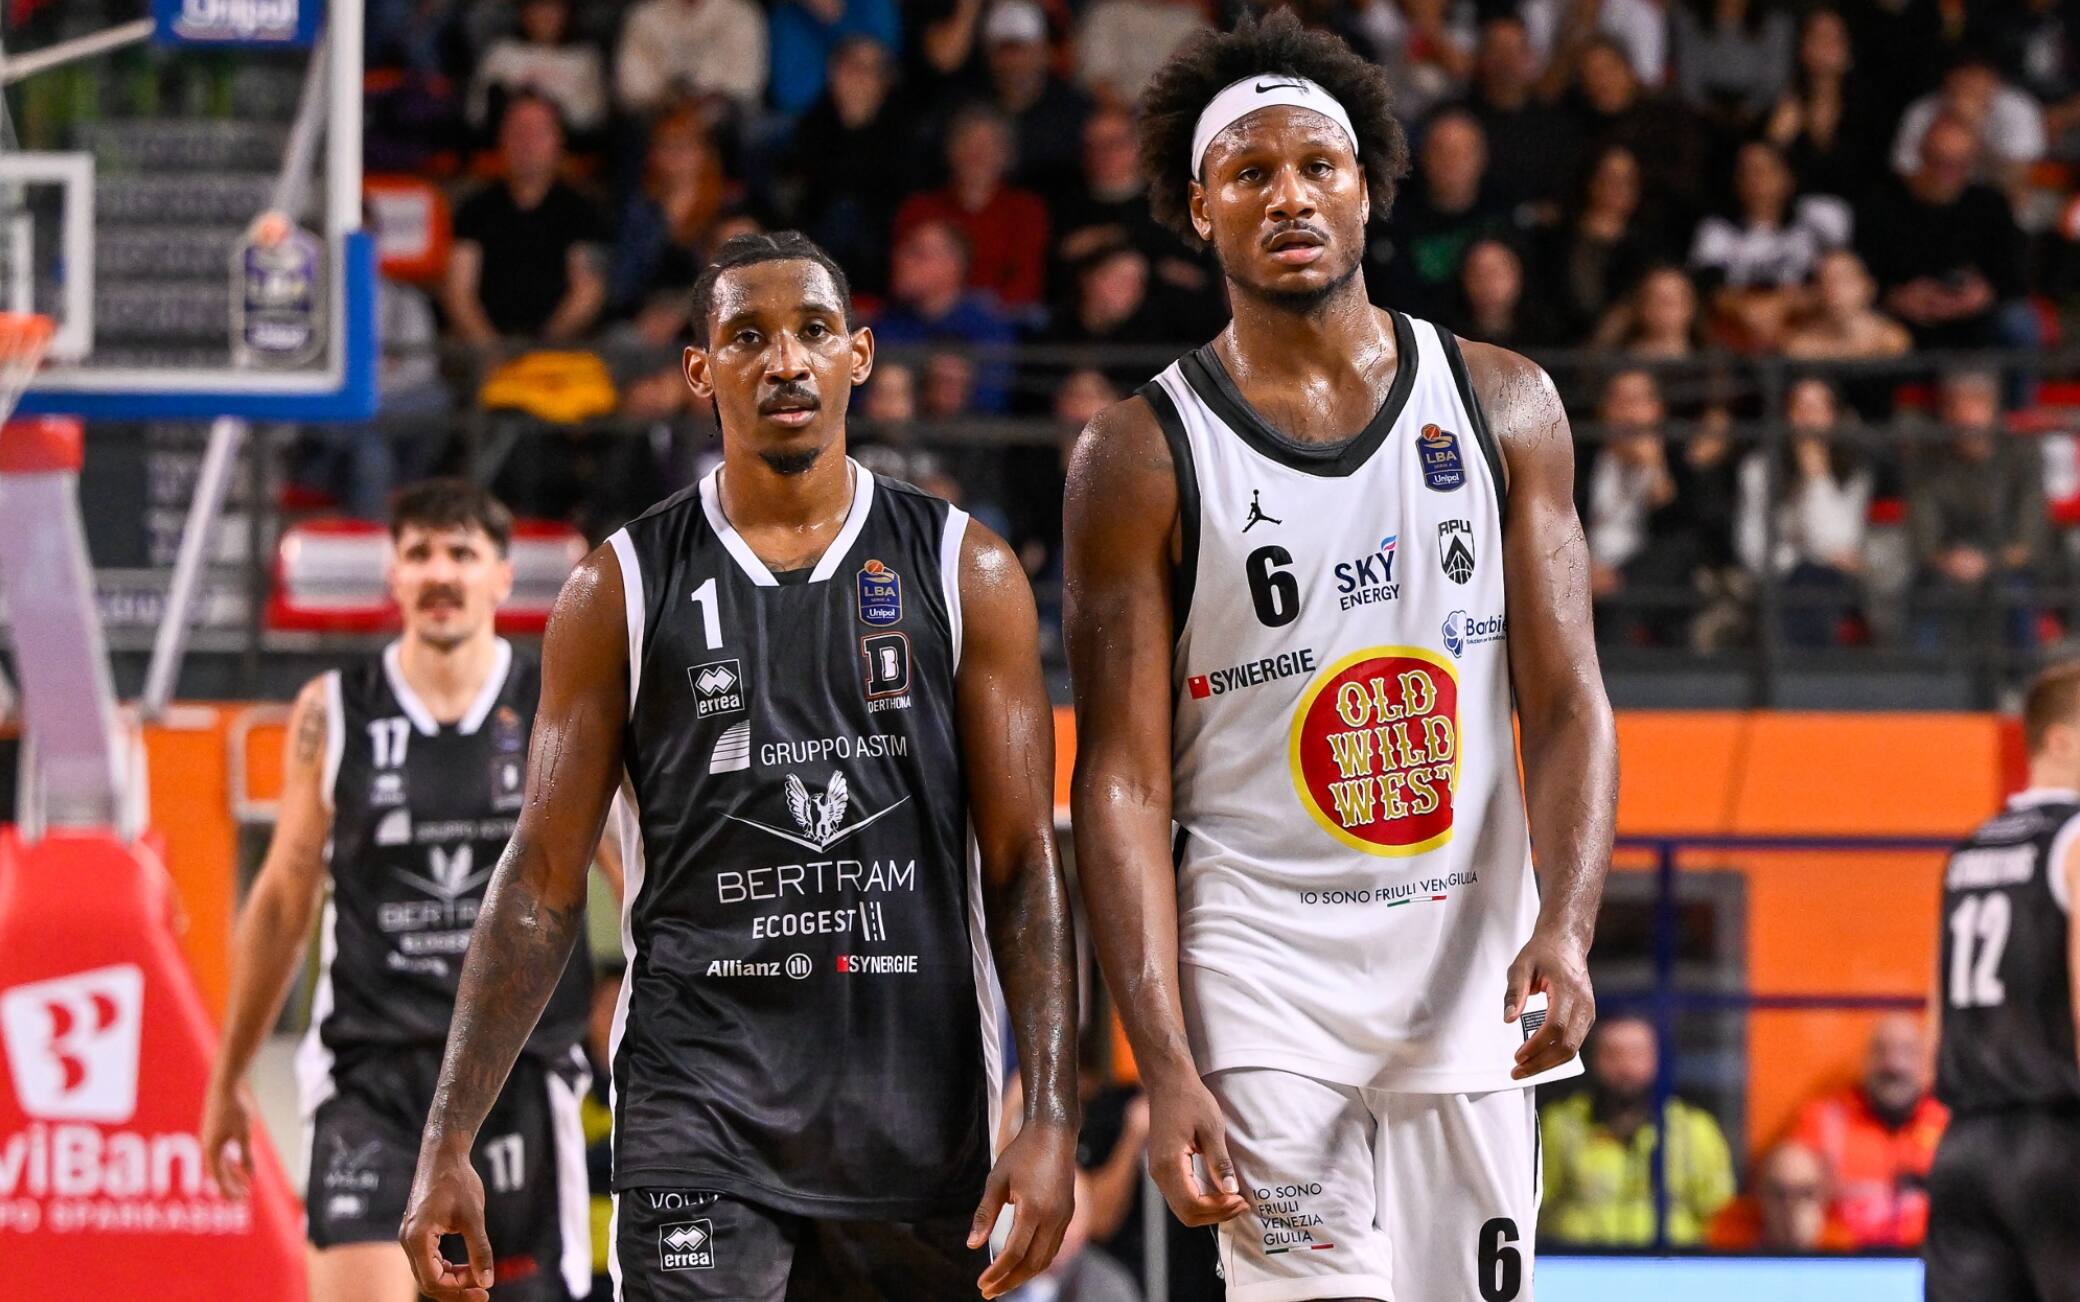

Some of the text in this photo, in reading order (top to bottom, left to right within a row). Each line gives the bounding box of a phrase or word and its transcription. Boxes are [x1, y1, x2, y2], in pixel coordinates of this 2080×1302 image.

[1426, 451, 1457, 464] LBA
[1434, 472, 1460, 484] Unipol
[1438, 520, 1471, 537] APU
[1334, 550, 1395, 593] SKY
[864, 586, 896, 597] LBA
[1246, 545, 1299, 628] 6
[1340, 584, 1400, 611] ENERGY
[691, 578, 723, 650] 1
[869, 608, 896, 619] Unipol
[1209, 649, 1316, 696] SYNERGIE
[867, 696, 912, 713] DERTHONA
[1336, 669, 1437, 728] OLD
[760, 734, 908, 766] GRUPPO ASTM
[1327, 714, 1455, 778] WILD
[717, 859, 916, 904] BERTRAM
[1300, 891, 1317, 904] IO
[1322, 890, 1371, 904] SONO
[1376, 882, 1416, 901] FRIULI
[752, 909, 856, 939] ECOGEST
[1950, 891, 2011, 1009] 12
[706, 955, 918, 977] Allianz SYNERGIE
[1252, 1183, 1322, 1200] IO SONO
[1258, 1201, 1299, 1216] FRIULI
[1261, 1214, 1323, 1230] VENEZIA
[1263, 1231, 1313, 1246] GIULIA
[1478, 1217, 1521, 1302] 6
